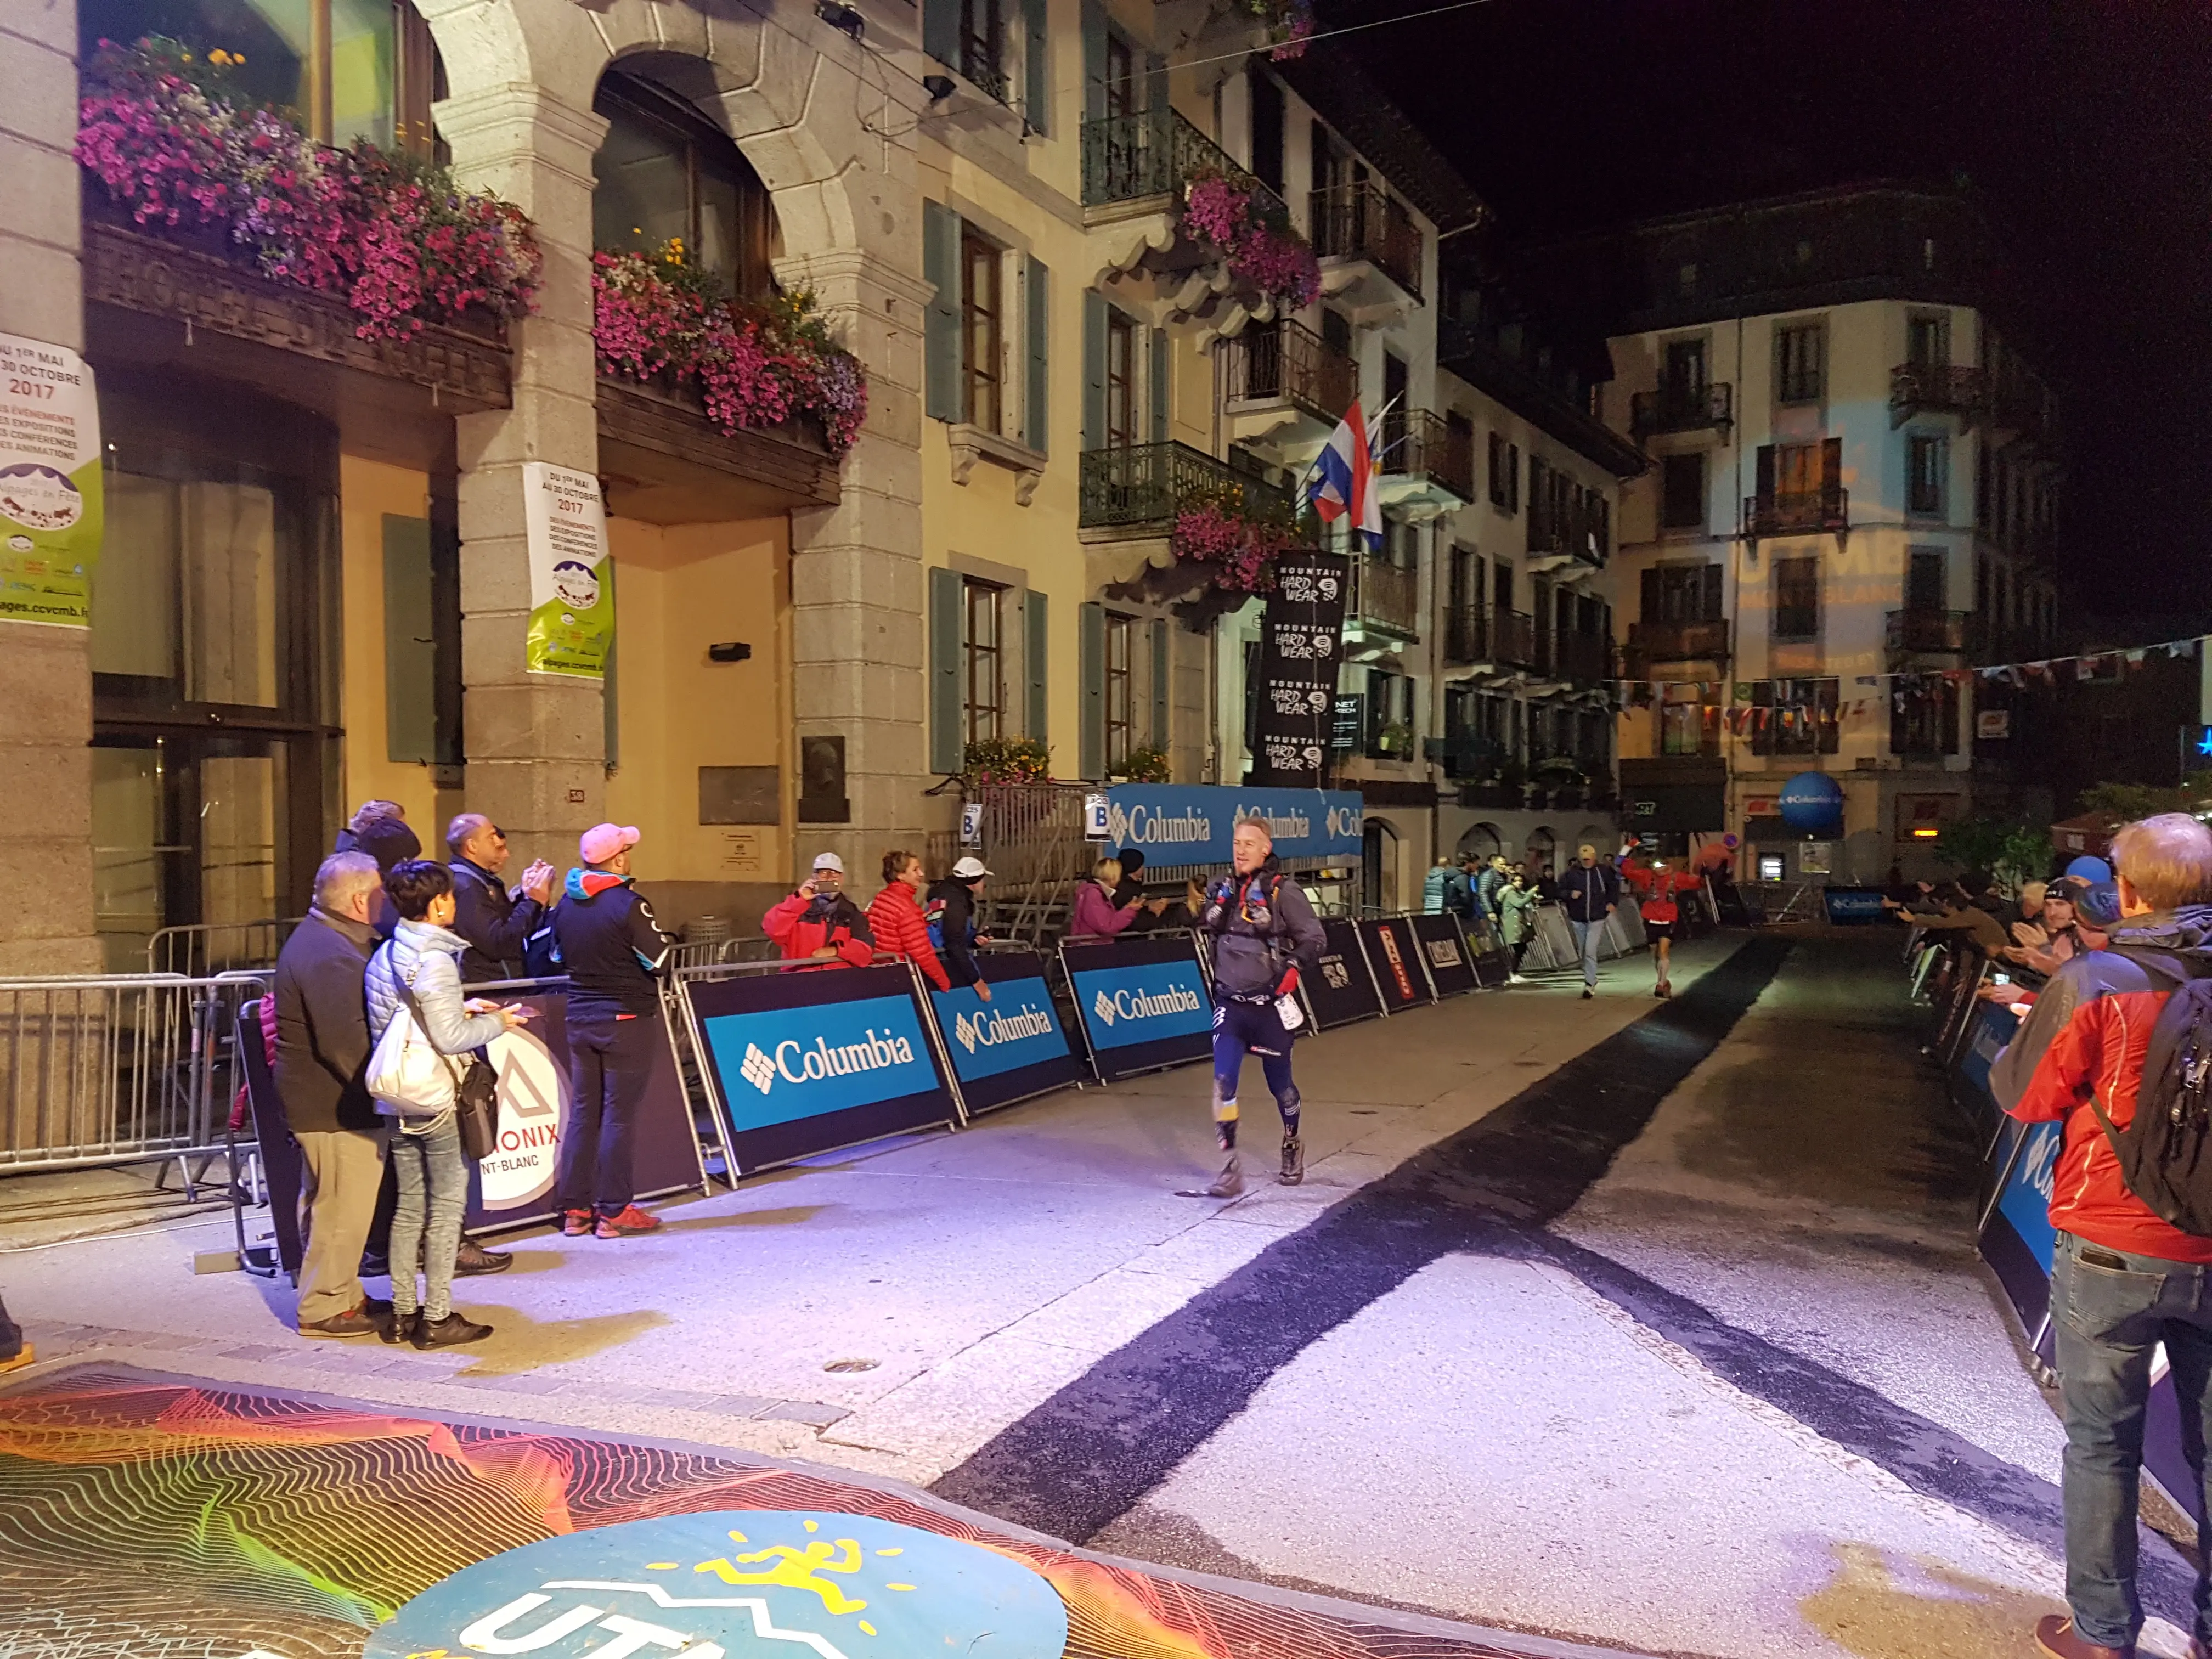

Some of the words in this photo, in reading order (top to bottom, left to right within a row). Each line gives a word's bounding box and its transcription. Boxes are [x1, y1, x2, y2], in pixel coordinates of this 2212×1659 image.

[38, 351, 64, 367] MAI
[1, 359, 15, 371] 30
[20, 364, 81, 386] OCTOBRE
[9, 377, 54, 399] 2017
[565, 488, 599, 503] OCTOBRE
[558, 499, 584, 514] 2017
[1280, 575, 1312, 590] HARD
[1285, 589, 1319, 603] WEAR
[1275, 633, 1306, 647] HARD
[1280, 645, 1313, 660] WEAR
[1271, 689, 1302, 703] HARD
[1276, 701, 1308, 715] WEAR
[1266, 744, 1296, 758] HARD
[1271, 756, 1304, 771] WEAR
[1096, 806, 1107, 827] B
[964, 815, 973, 835] B
[1129, 805, 1211, 844] Columbia
[1115, 984, 1200, 1020] Columbia
[973, 1003, 1052, 1046] Columbia
[775, 1028, 915, 1084] Columbia
[495, 1123, 561, 1153] ONIX
